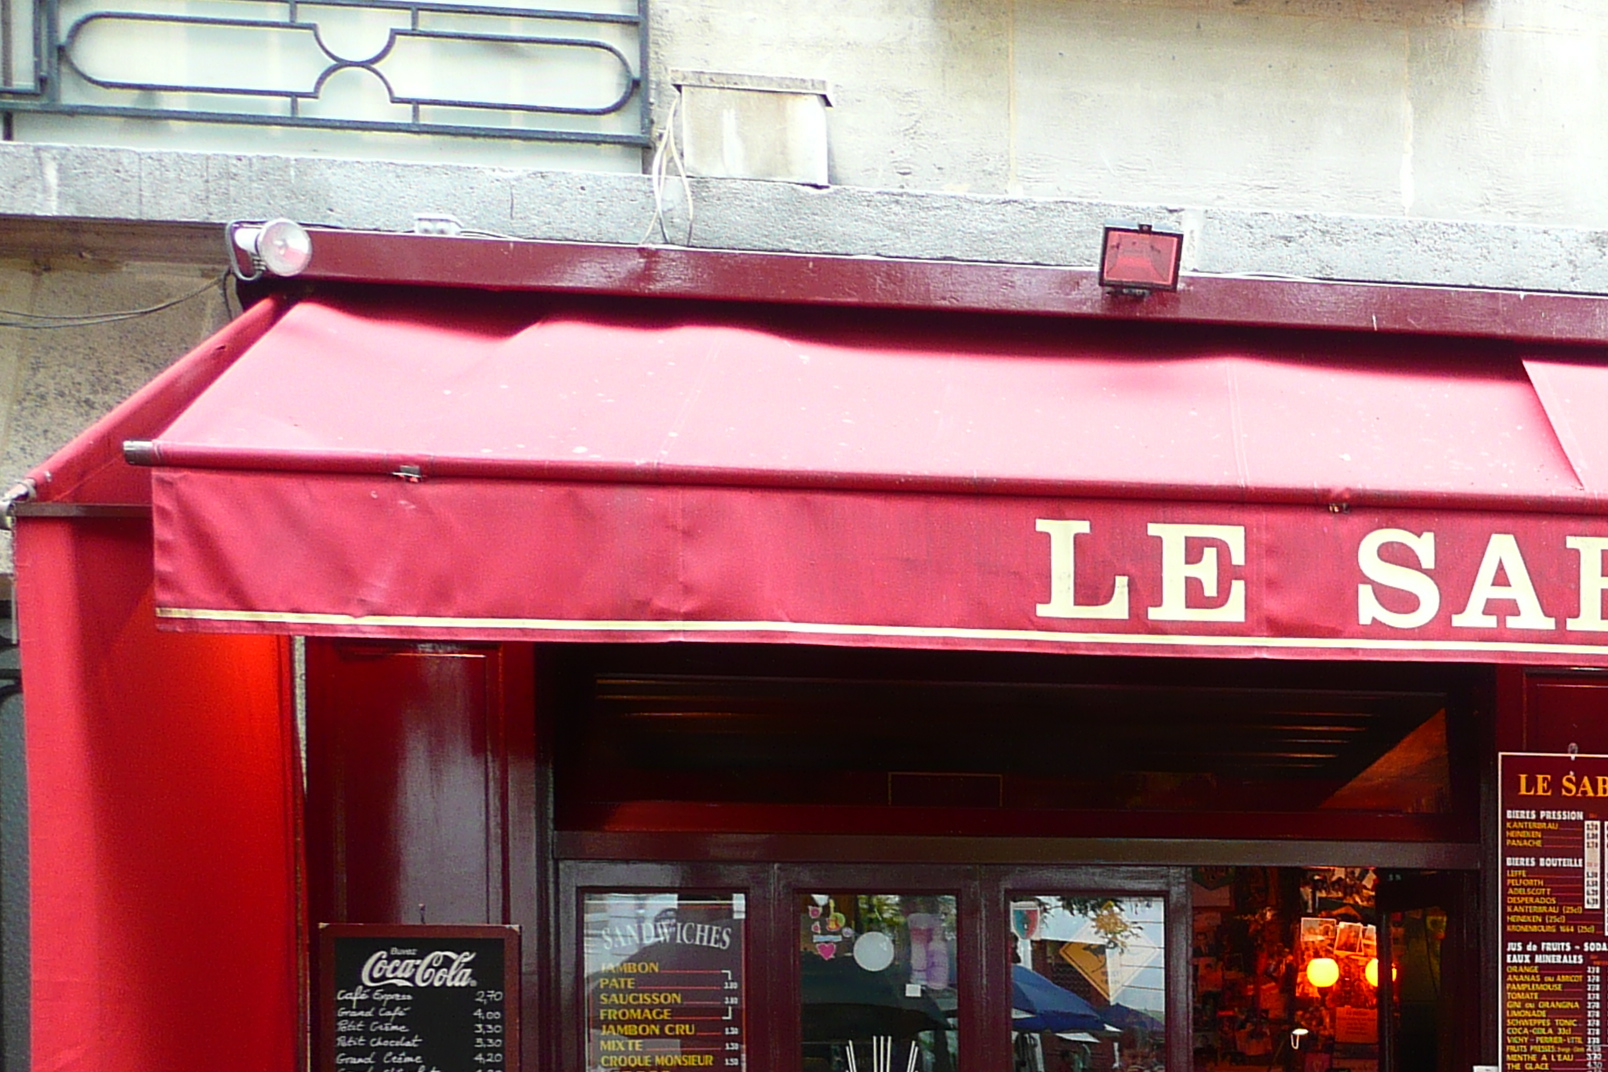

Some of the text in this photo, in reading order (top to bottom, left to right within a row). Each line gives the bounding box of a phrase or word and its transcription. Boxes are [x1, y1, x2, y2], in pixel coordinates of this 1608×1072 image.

[1035, 518, 1245, 622] LE
[1518, 774, 1552, 796] LE
[1506, 810, 1536, 819] BIERES
[1540, 810, 1584, 820] PRESSION
[1506, 858, 1583, 867] BIERES BOUTEILLE
[601, 920, 732, 950] SANDWICHES
[1506, 942, 1522, 951] JUS
[1526, 942, 1538, 951] de
[1541, 942, 1571, 951] FRUITS
[1506, 954, 1530, 964] EAUX
[1535, 954, 1583, 964] MINERALES
[600, 978, 636, 989] PATE
[336, 986, 503, 1009] Café Express 2,70
[600, 993, 682, 1004] SAUCISSON
[337, 1007, 501, 1022] Grand Café 4,00
[600, 1009, 672, 1020] FROMAGE
[337, 1020, 366, 1032] Petit
[474, 1024, 502, 1035] 3,30
[600, 1024, 695, 1036] JAMBON CRU
[336, 1036, 366, 1046] Petit
[600, 1040, 643, 1050] MIXTE
[336, 1052, 375, 1064] Grand
[473, 1053, 502, 1064] 4,20
[600, 1054, 713, 1066] CROQUE MONSIEUR
